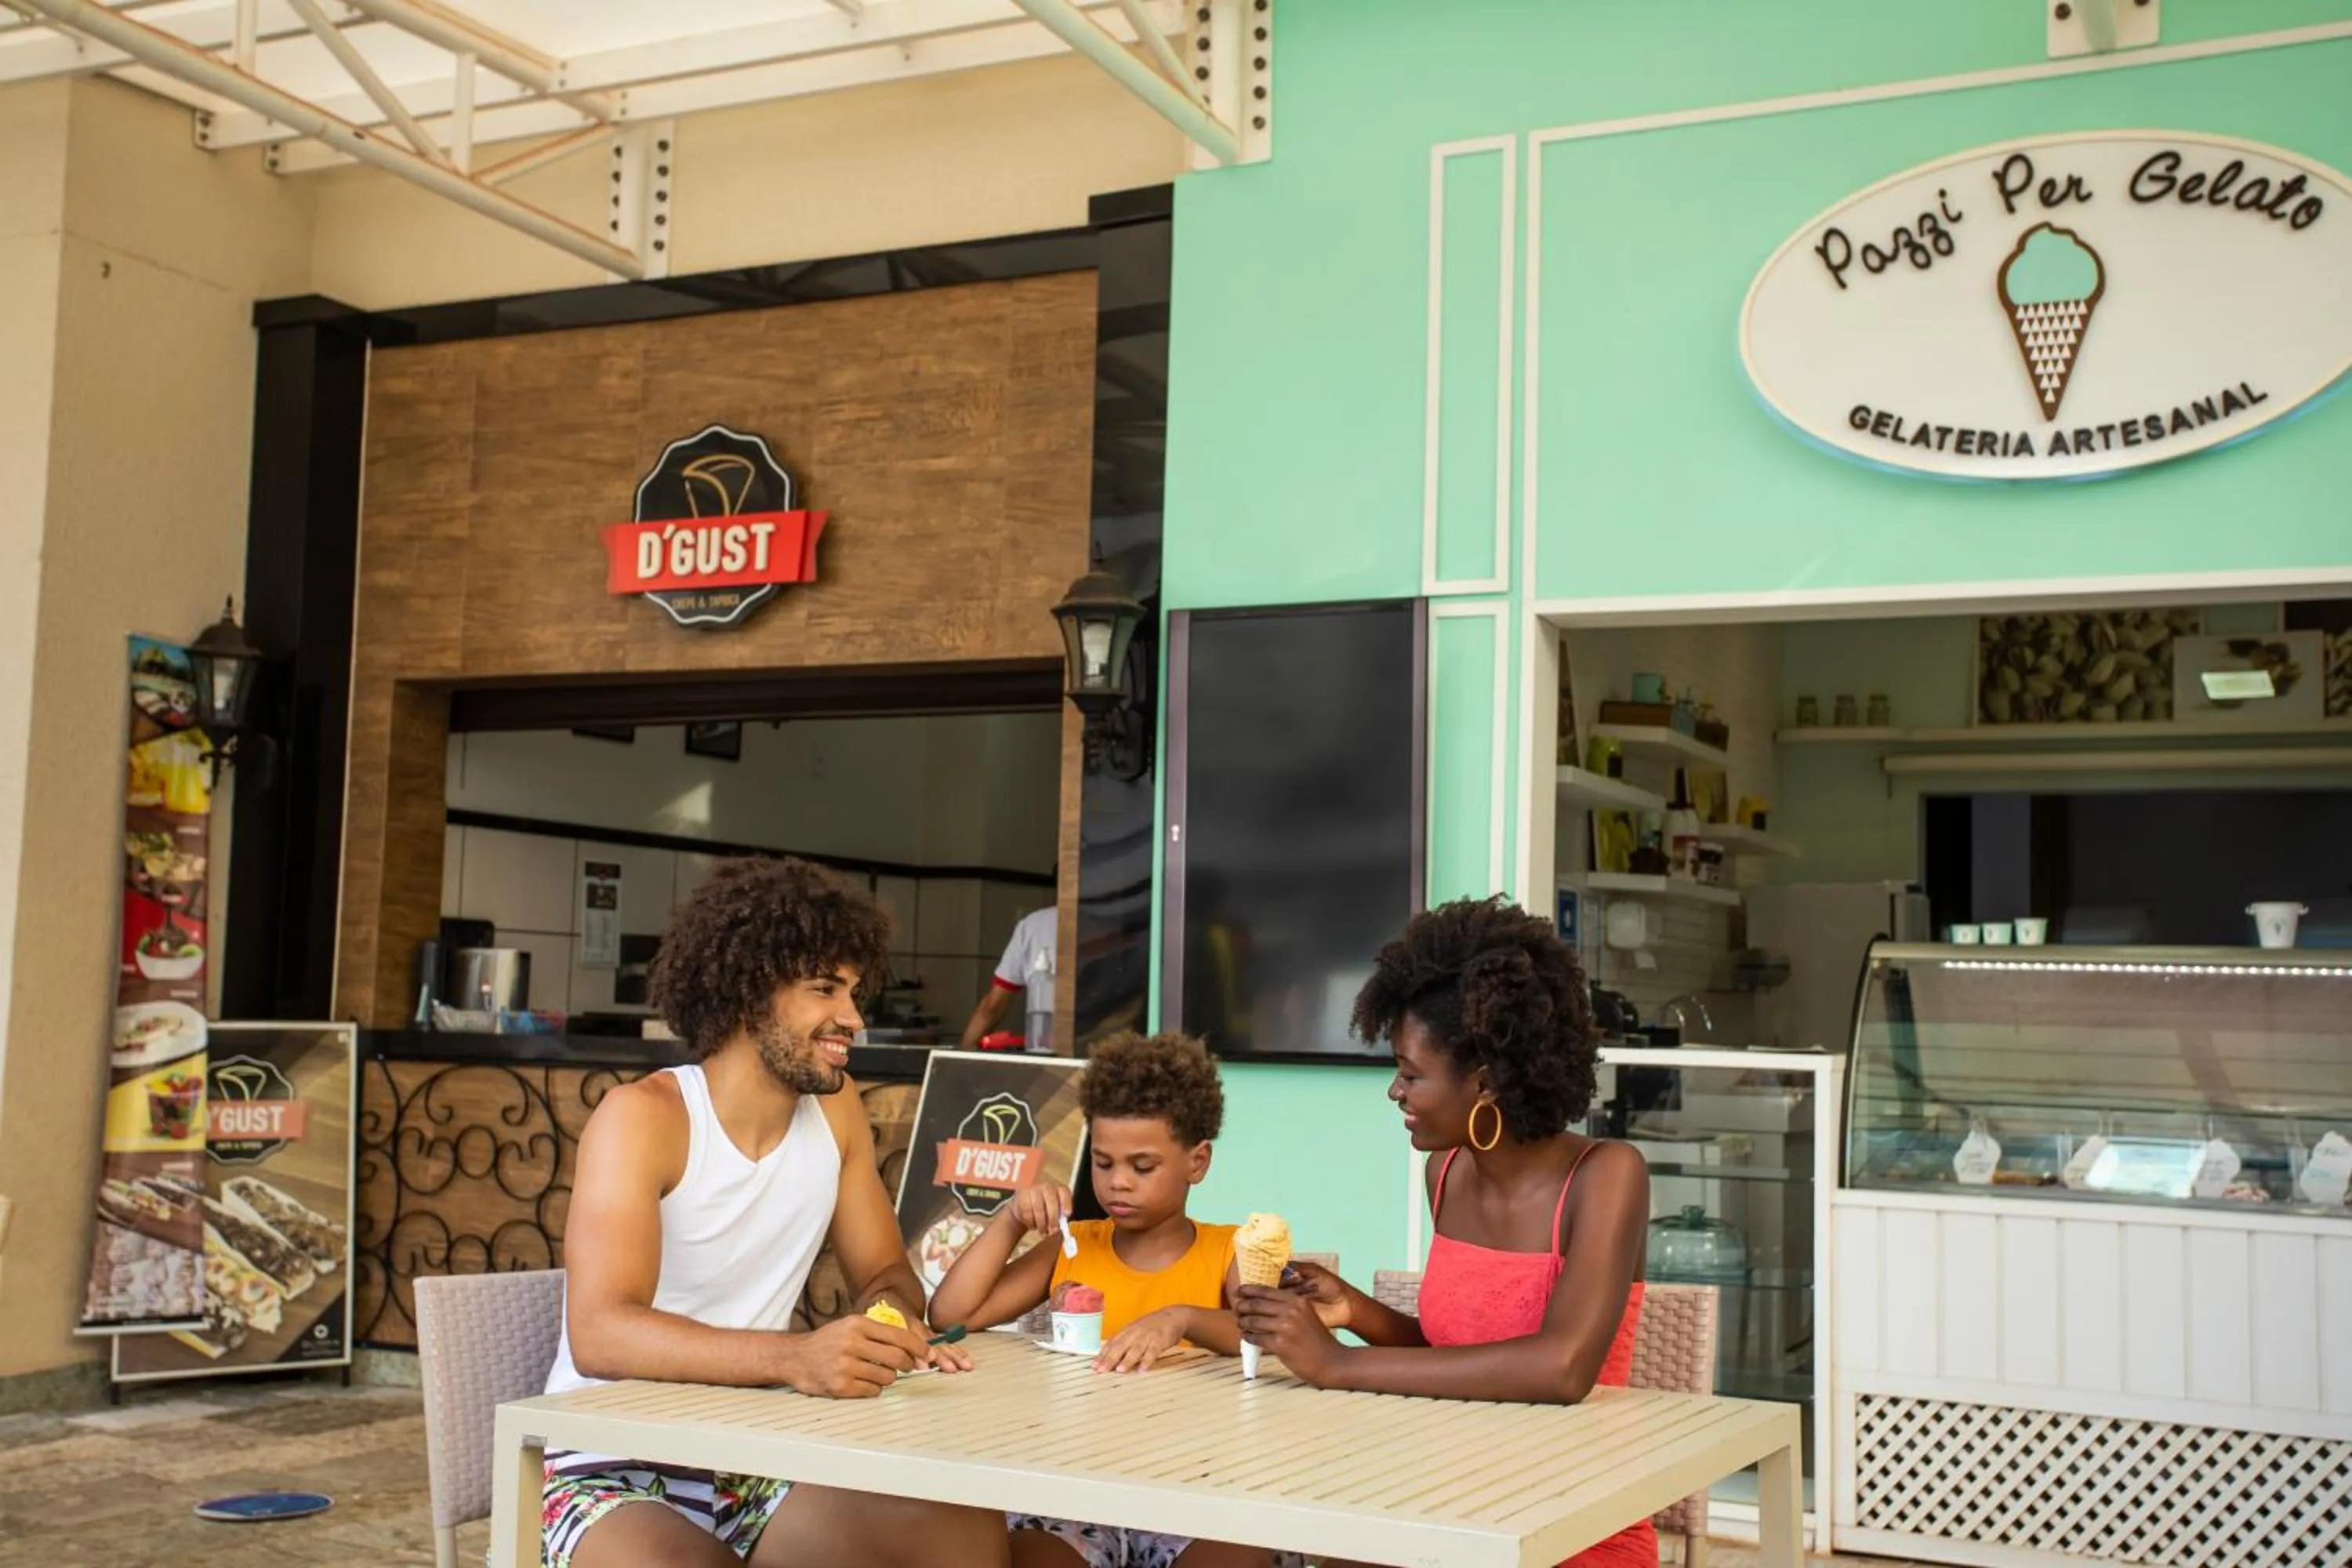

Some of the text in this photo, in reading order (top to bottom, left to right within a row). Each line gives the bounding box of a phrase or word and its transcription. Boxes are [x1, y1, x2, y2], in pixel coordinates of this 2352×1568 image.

[1813, 150, 2325, 290] Pazzi Per Gelato
[1848, 382, 2269, 458] GELATERIA ARTESANAL
[637, 523, 775, 578] D'GUST
[956, 1147, 1026, 1182] D'GUST
